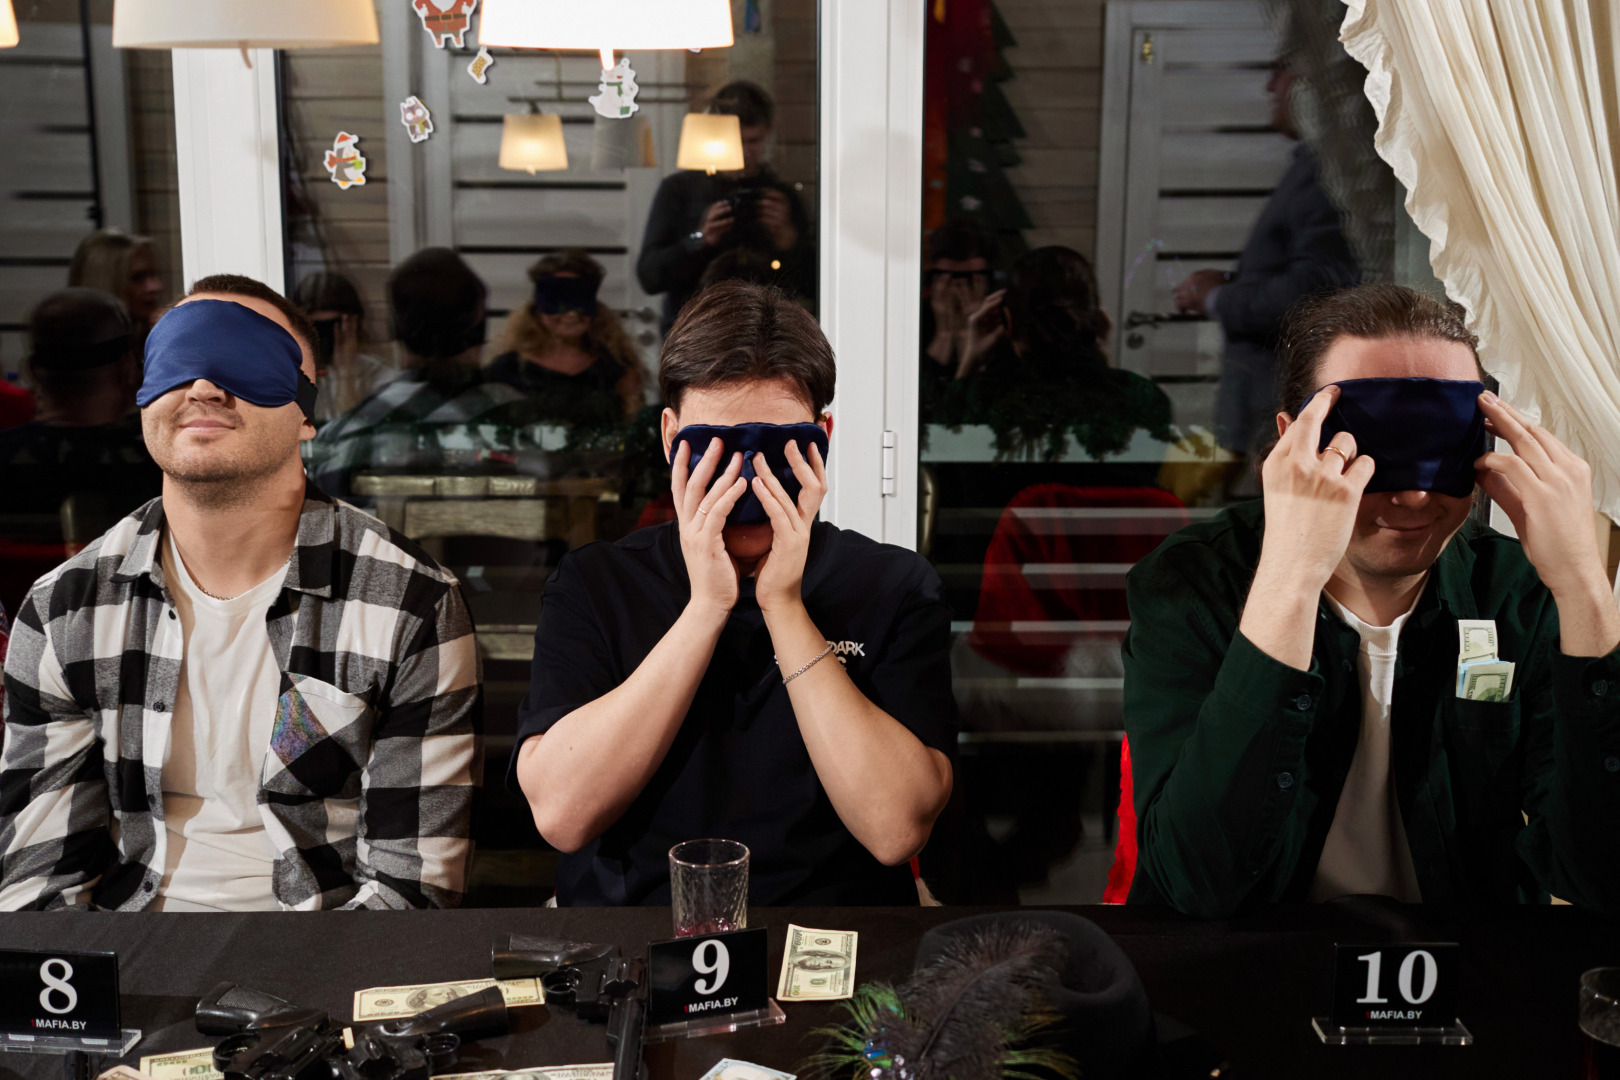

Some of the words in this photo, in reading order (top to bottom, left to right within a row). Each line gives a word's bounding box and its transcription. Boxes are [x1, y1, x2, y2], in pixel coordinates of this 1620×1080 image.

[39, 958, 78, 1014] 8
[692, 939, 730, 995] 9
[1356, 949, 1438, 1004] 10
